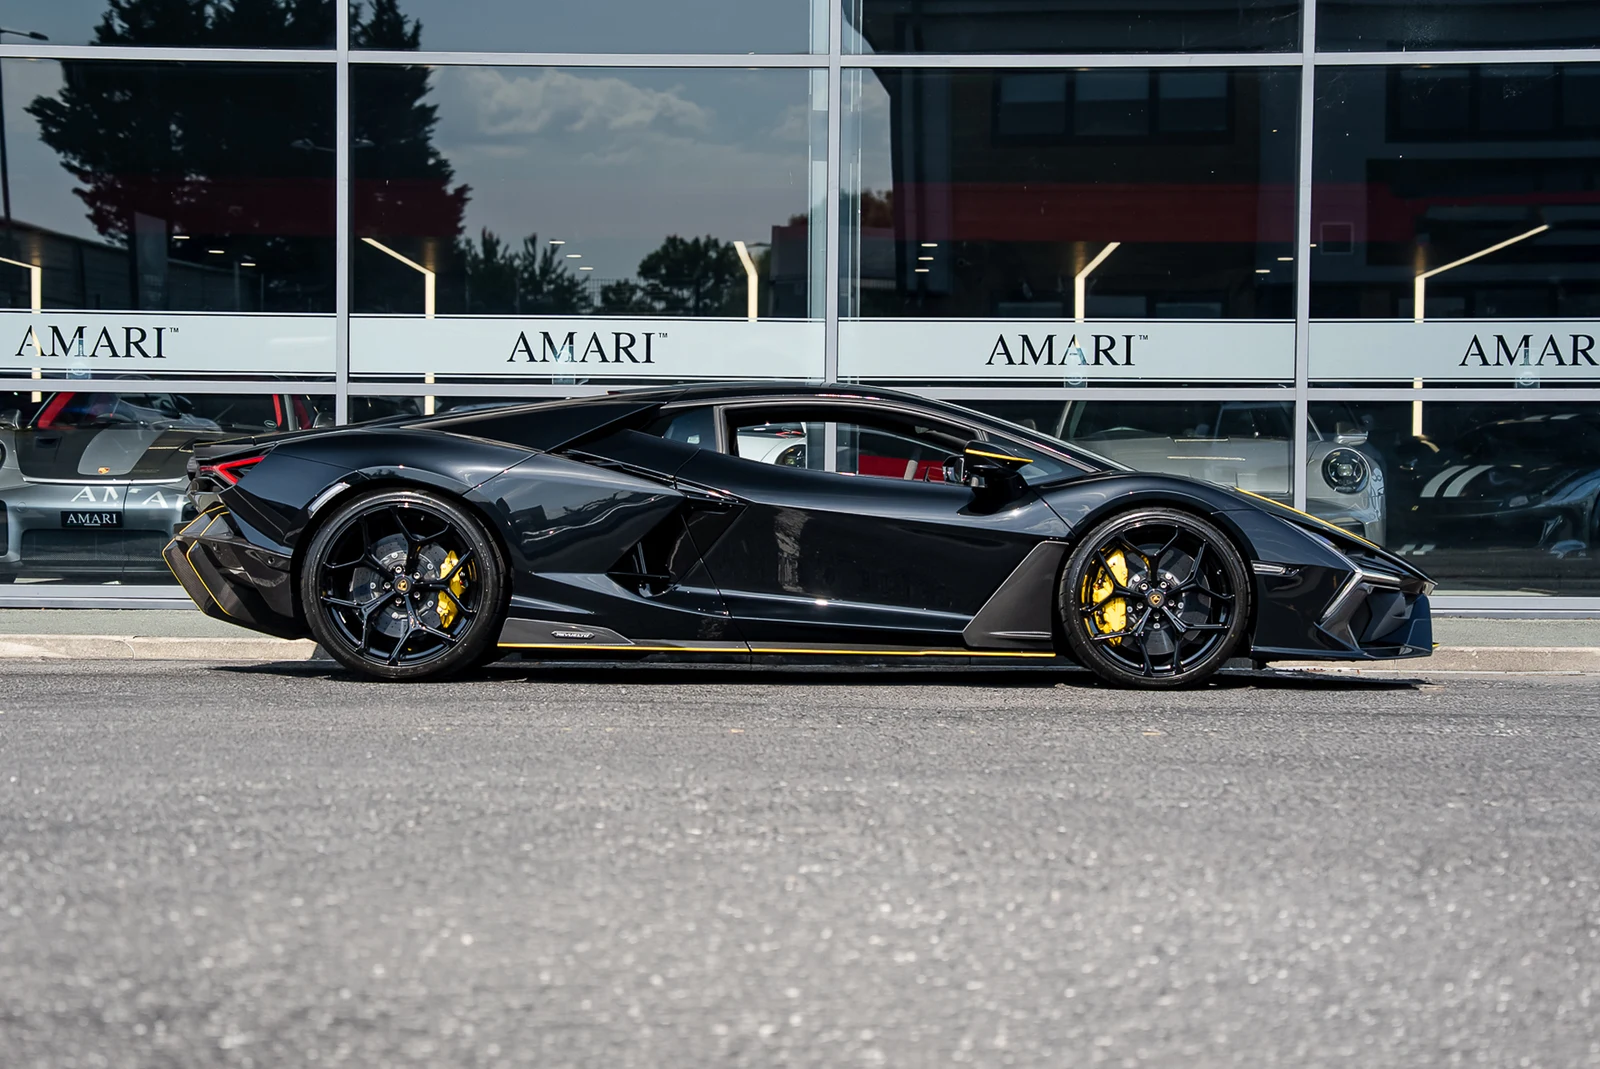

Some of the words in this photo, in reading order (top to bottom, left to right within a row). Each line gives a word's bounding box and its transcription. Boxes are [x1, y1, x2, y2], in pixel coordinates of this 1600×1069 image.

[15, 325, 166, 358] AMARI
[506, 331, 655, 363] AMARI
[985, 334, 1136, 366] AMARI
[1458, 334, 1600, 366] AMAR
[67, 513, 117, 524] AMARI
